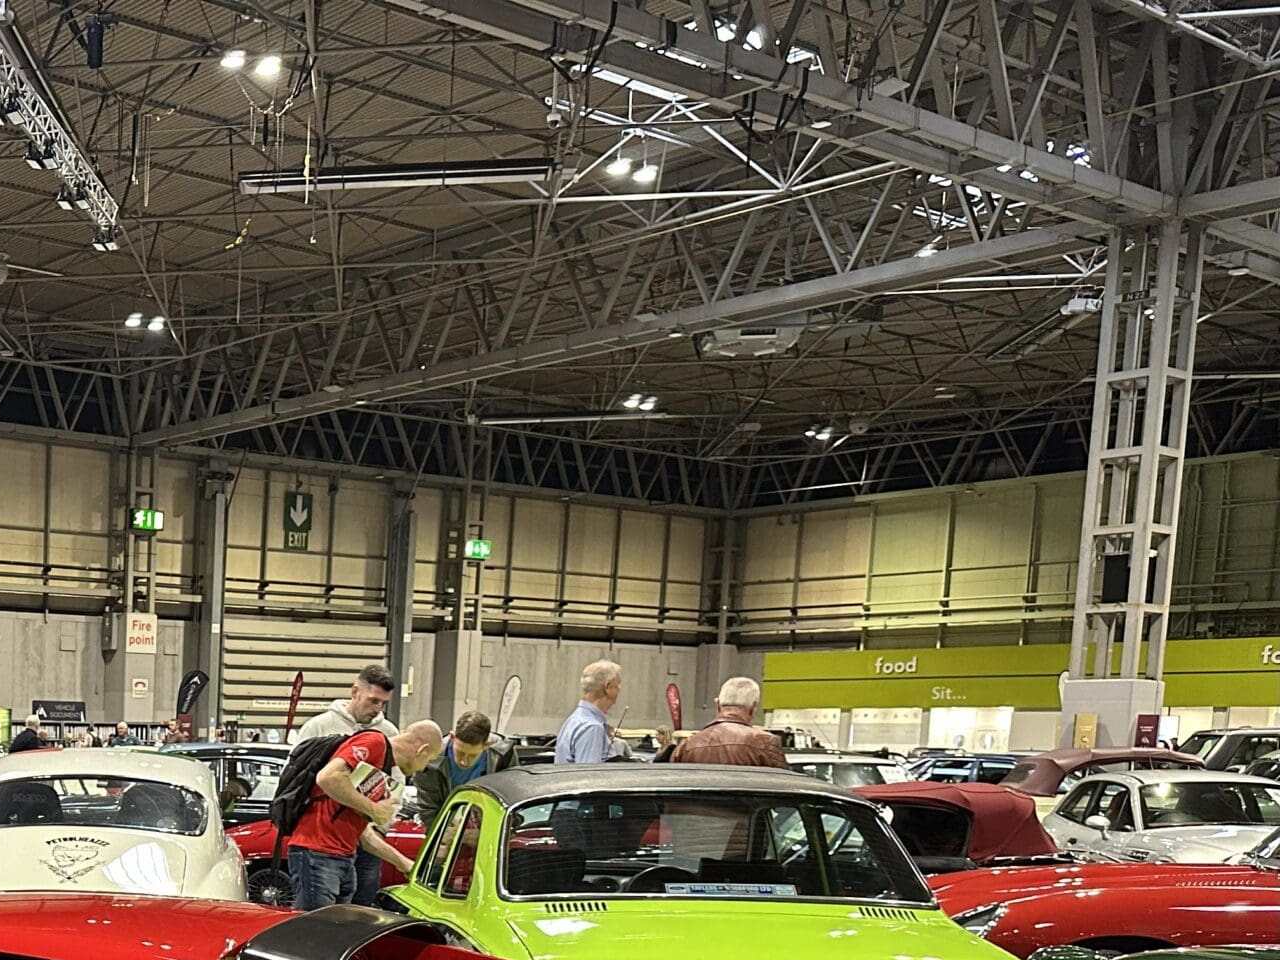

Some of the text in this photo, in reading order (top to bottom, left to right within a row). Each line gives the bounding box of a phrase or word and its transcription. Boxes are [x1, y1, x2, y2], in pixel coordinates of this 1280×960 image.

[289, 531, 308, 548] EXIT
[132, 620, 152, 632] Fire
[129, 635, 155, 647] point
[875, 656, 917, 673] food
[931, 686, 967, 700] Sit...
